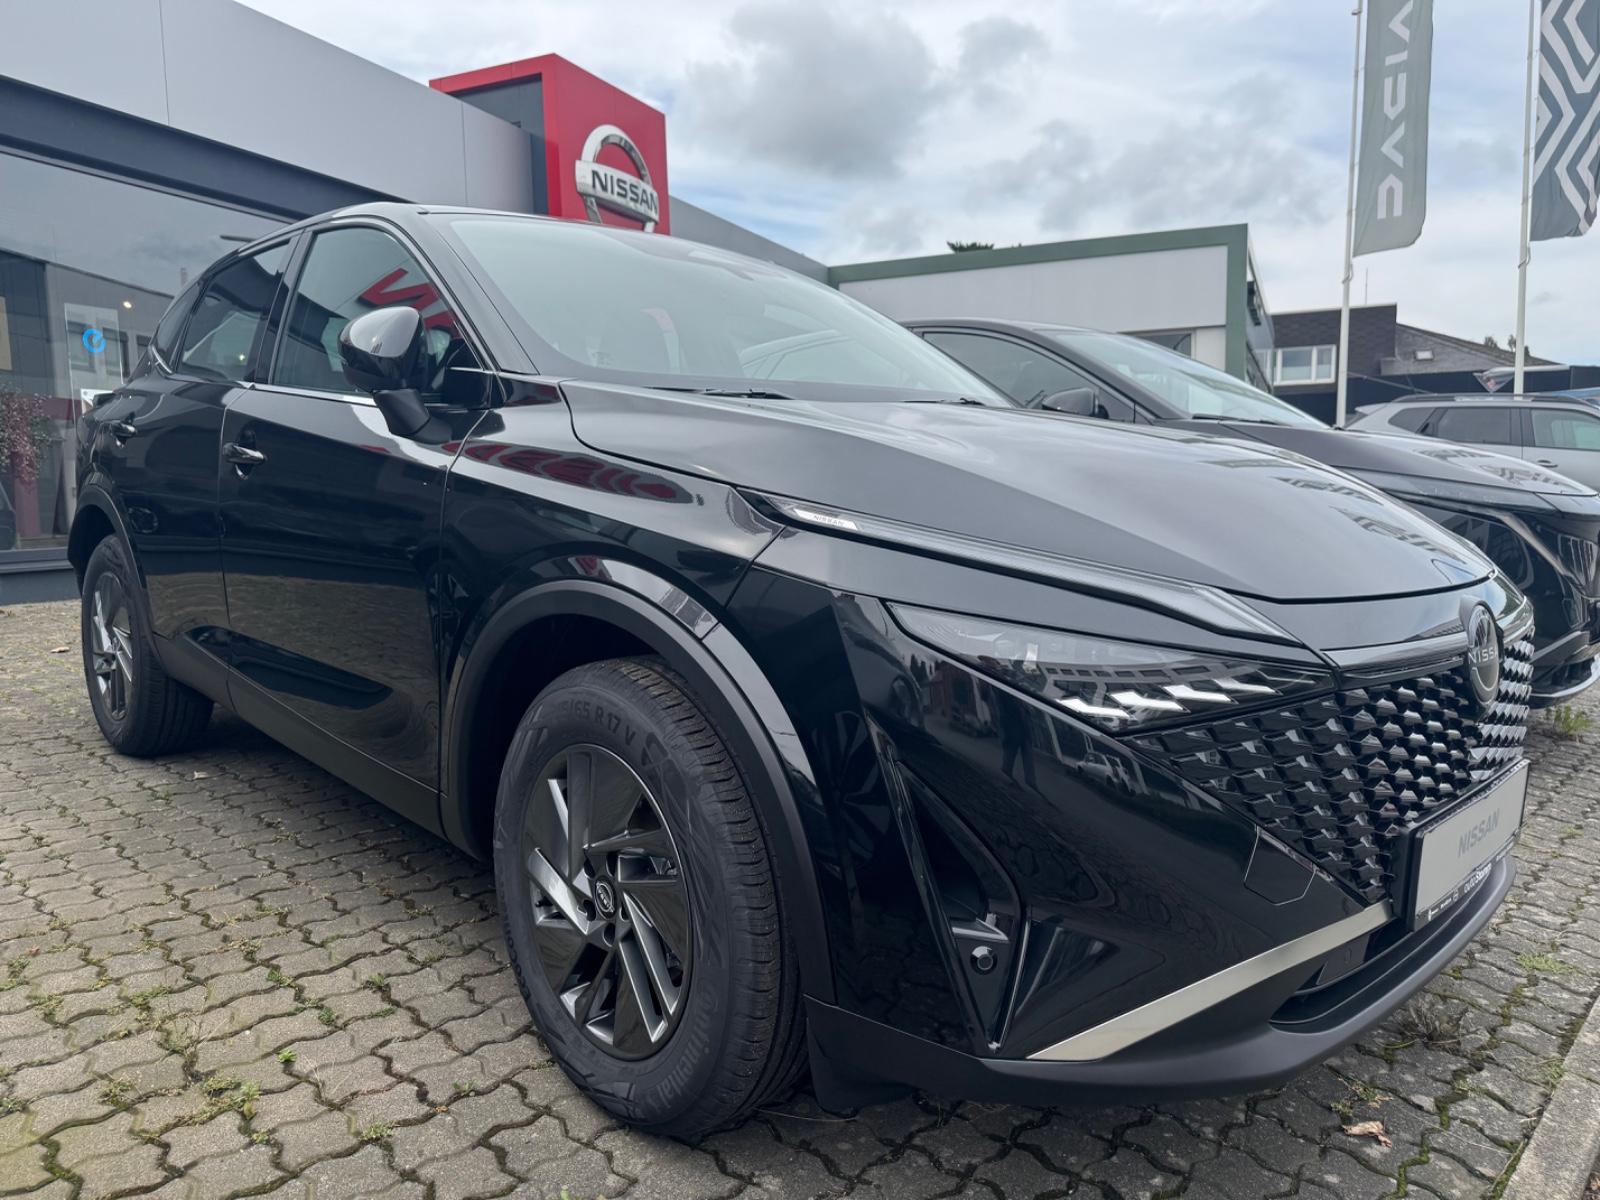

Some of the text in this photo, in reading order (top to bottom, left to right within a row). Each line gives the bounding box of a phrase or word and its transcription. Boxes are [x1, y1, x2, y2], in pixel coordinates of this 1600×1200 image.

[1376, 0, 1414, 220] DACIA
[591, 169, 658, 216] NISSAN
[813, 514, 846, 528] NISSAN
[1468, 646, 1498, 665] NISS
[1457, 807, 1501, 859] NISSAN
